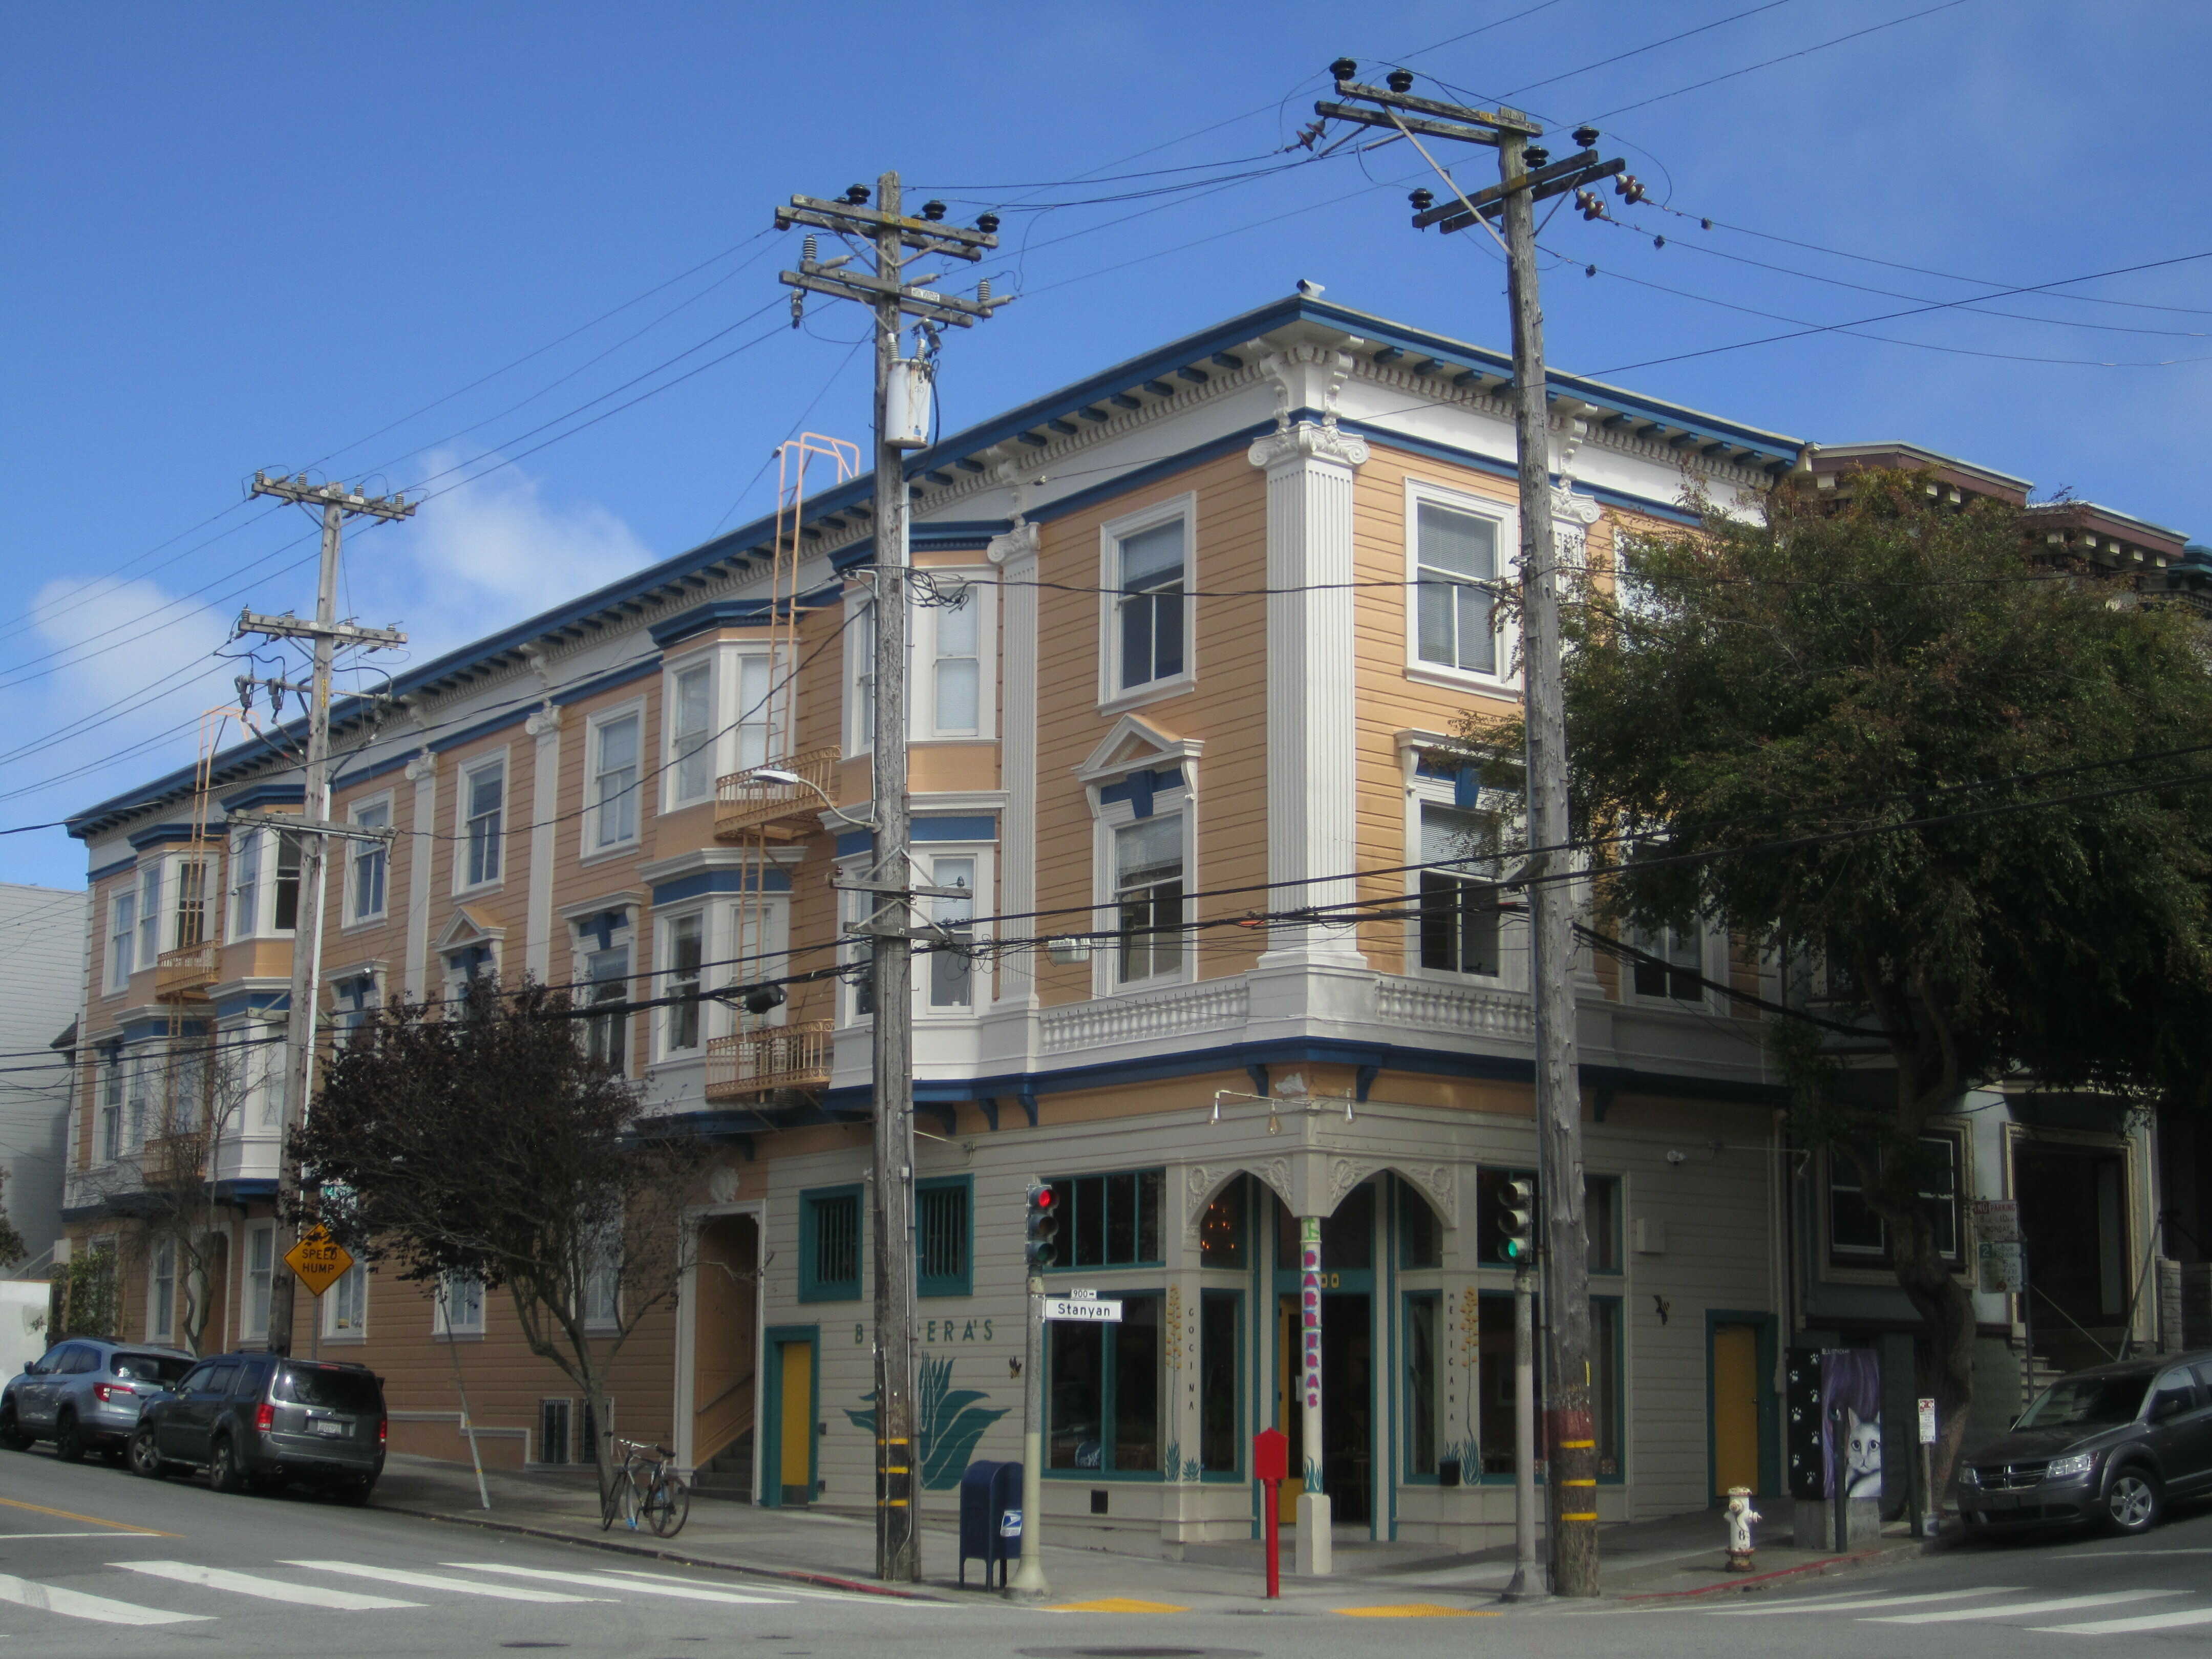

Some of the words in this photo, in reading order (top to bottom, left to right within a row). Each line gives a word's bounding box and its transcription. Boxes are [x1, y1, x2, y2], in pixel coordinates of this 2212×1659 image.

[1990, 1204, 2016, 1212] PARKING
[302, 1249, 337, 1260] SPEED
[1982, 1245, 1989, 1256] 2
[303, 1263, 334, 1273] HUMP
[1073, 1290, 1088, 1298] 900
[1058, 1303, 1110, 1318] Stanyan
[855, 1318, 993, 1344] BERA'S
